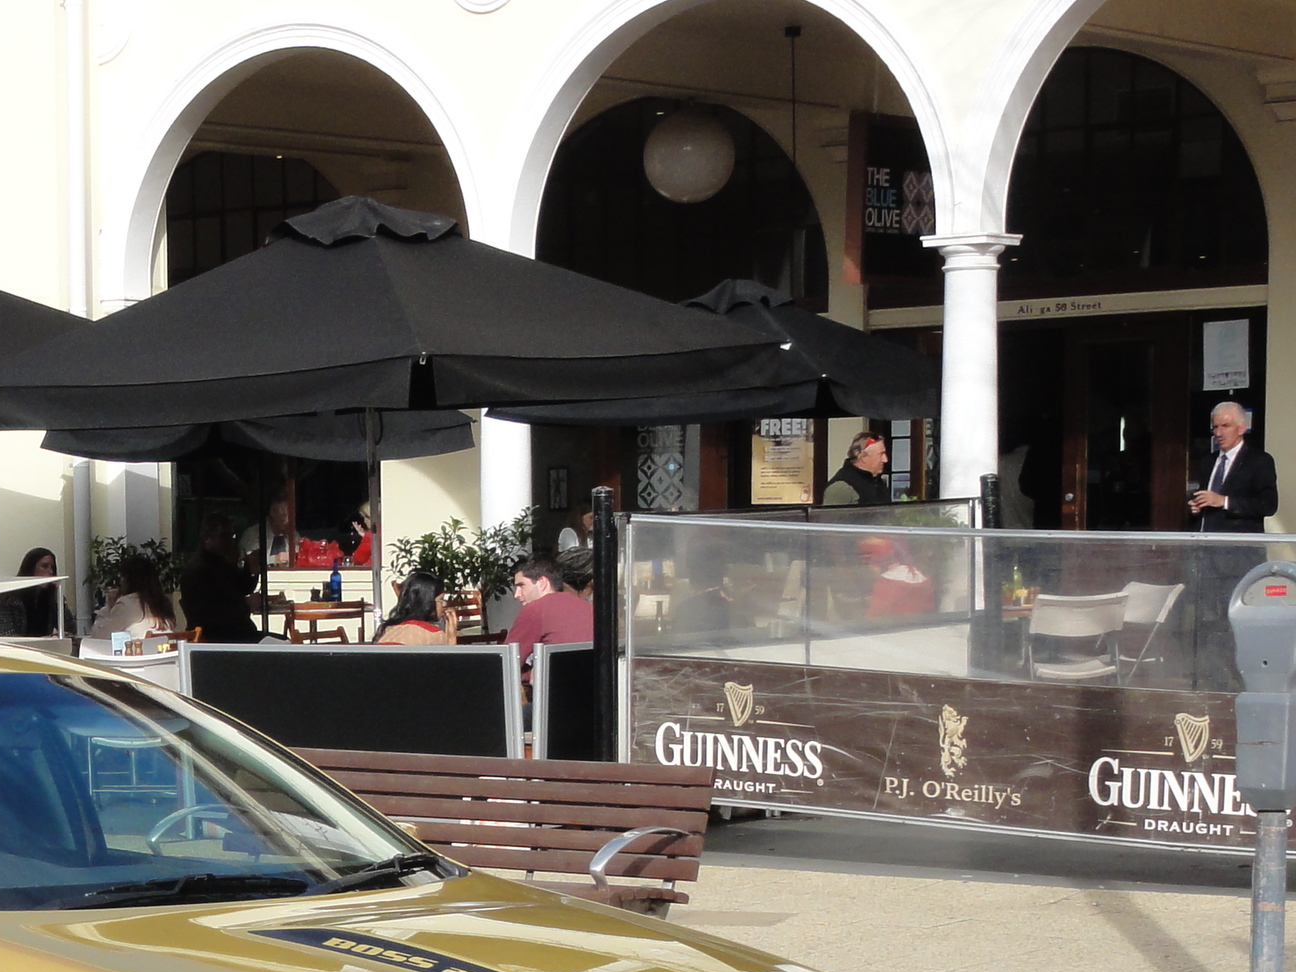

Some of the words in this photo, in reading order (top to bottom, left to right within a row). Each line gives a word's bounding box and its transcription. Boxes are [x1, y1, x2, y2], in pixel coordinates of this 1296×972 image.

[867, 167, 890, 187] THE
[866, 187, 897, 207] BLUE
[865, 207, 900, 228] OLIVE
[1070, 301, 1102, 311] Street
[760, 418, 808, 436] FREE!
[716, 702, 725, 713] 17
[754, 705, 765, 715] 59
[655, 721, 824, 780] GUINNESS
[1163, 736, 1174, 747] 17
[1210, 738, 1223, 750] 59
[713, 778, 776, 794] RAUGHT
[884, 776, 915, 799] P.J.
[922, 780, 1022, 810] O'Reilly's
[1088, 756, 1260, 818] GUINNE
[1143, 818, 1234, 836] DRAUGHT
[321, 936, 440, 970] BOSS
